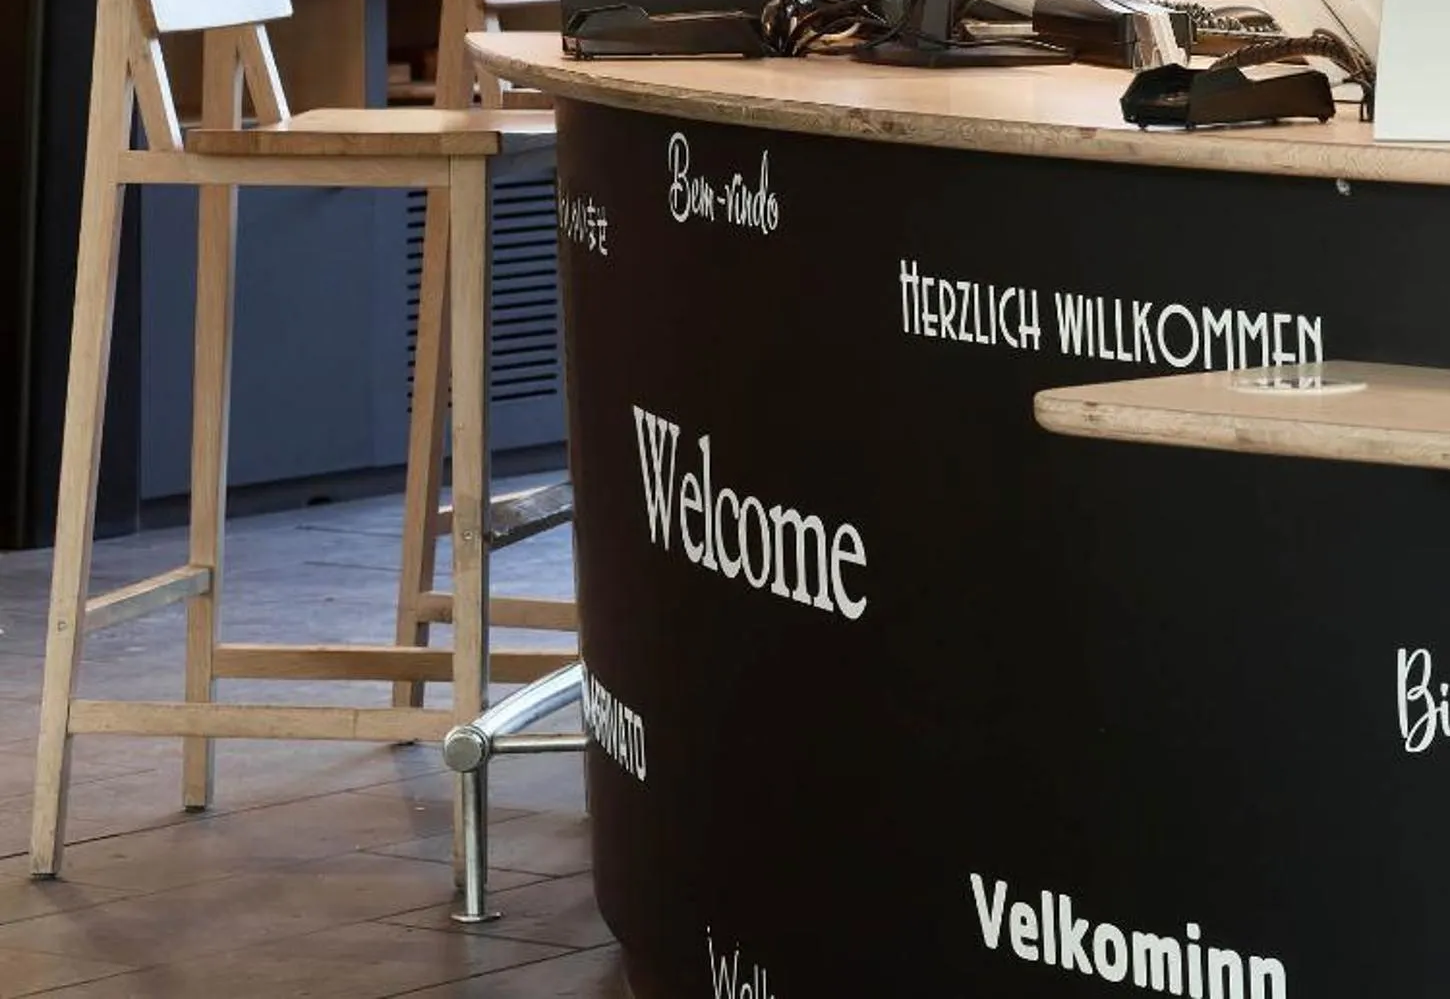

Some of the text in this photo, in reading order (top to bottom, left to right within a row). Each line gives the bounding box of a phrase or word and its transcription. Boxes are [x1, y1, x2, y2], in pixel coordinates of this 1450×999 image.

[668, 131, 779, 235] Bem-vindo
[900, 259, 1324, 372] HERZLICH WILLKOMMEN
[633, 404, 868, 620] Welcome
[970, 872, 1288, 999] Velkominn
